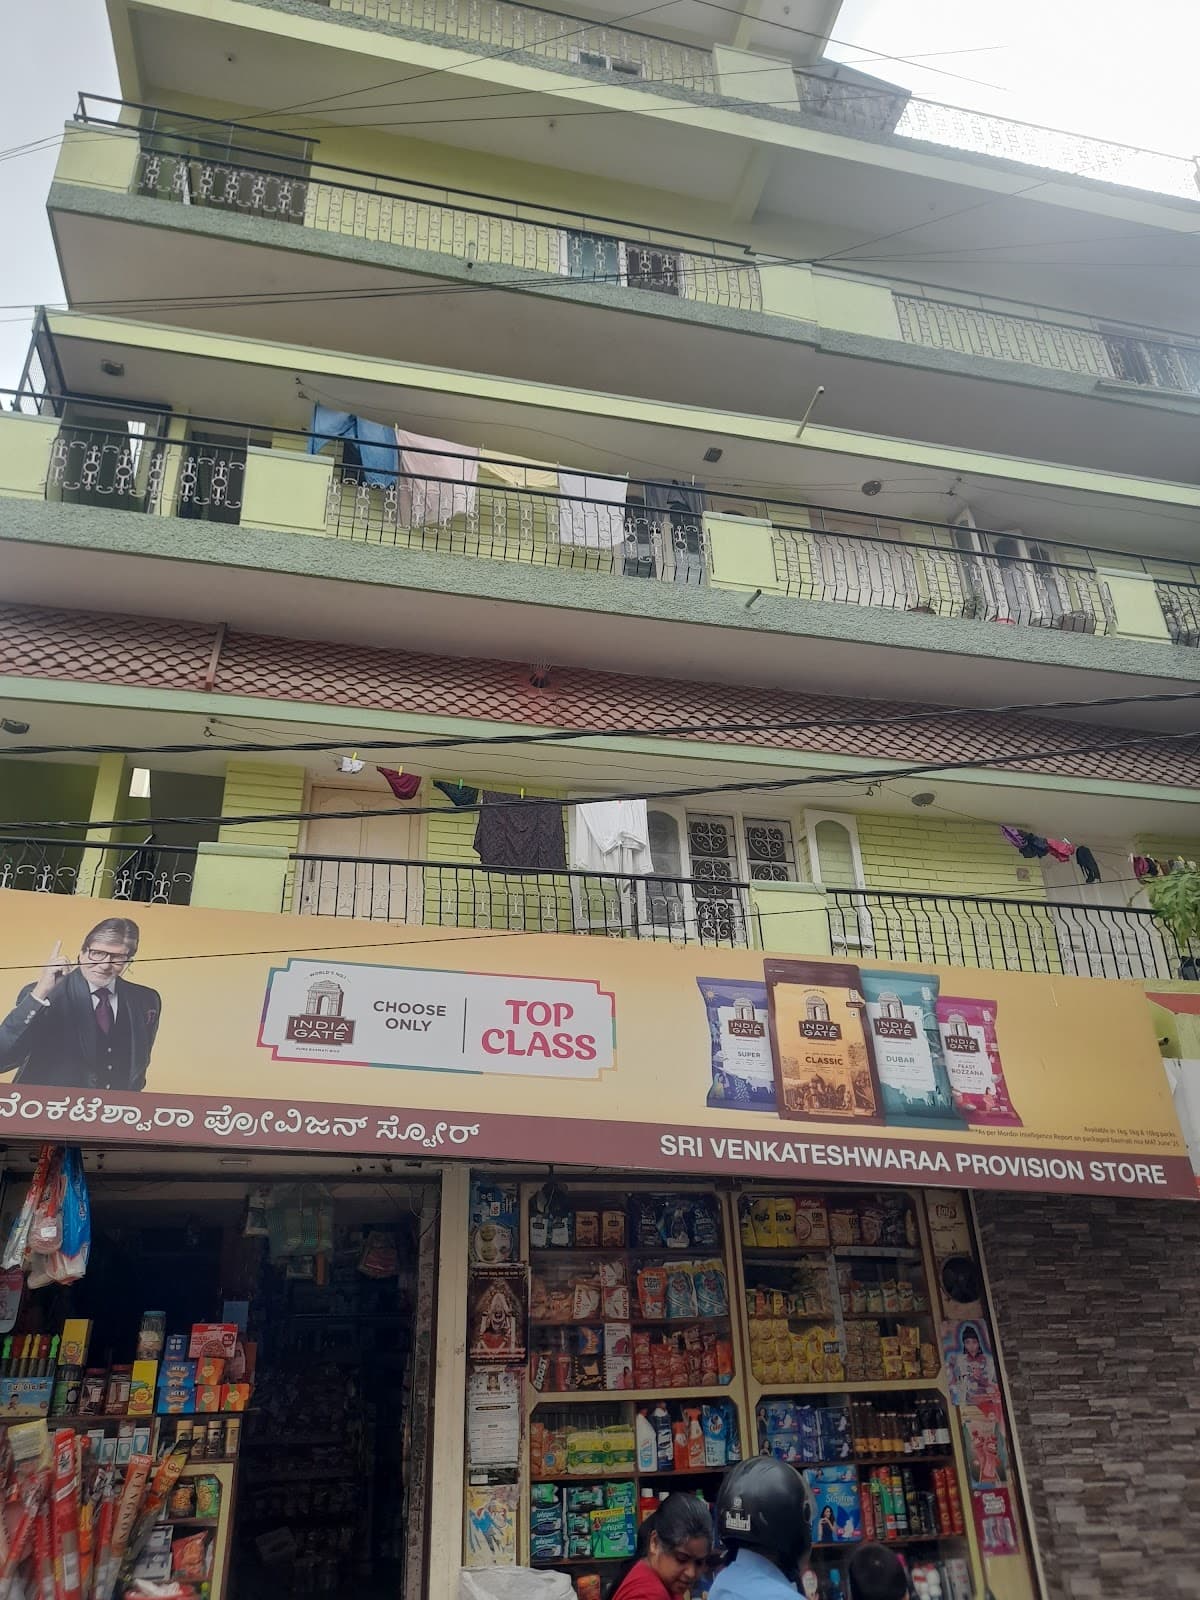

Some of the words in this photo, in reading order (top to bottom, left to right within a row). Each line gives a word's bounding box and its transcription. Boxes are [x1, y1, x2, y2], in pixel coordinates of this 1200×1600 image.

[373, 1000, 447, 1017] CHOOSE
[505, 999, 573, 1027] TOP
[293, 1019, 349, 1032] INDIA
[386, 1018, 432, 1032] ONLY
[730, 1022, 761, 1030] INDIA
[802, 1023, 838, 1032] INDIA
[877, 1021, 913, 1030] INDIA
[294, 1029, 345, 1041] GATE
[732, 1028, 760, 1036] GATE
[804, 1030, 837, 1039] GATE
[880, 1028, 912, 1037] GATE
[481, 1028, 597, 1060] CLASS
[947, 1038, 976, 1046] INDIA
[949, 1043, 977, 1051] GATE
[737, 1050, 761, 1059] SUPER
[805, 1056, 844, 1066] CLASSIC
[886, 1055, 915, 1064] DUBAR
[376, 1114, 480, 1148] ಸ್ಟೋರ್
[661, 1134, 703, 1158] SRI
[710, 1137, 952, 1173] VENKATESHWARAA
[956, 1154, 1086, 1182] PROVISION
[1090, 1161, 1168, 1185] STORE
[533, 1356, 547, 1391] BOOST
